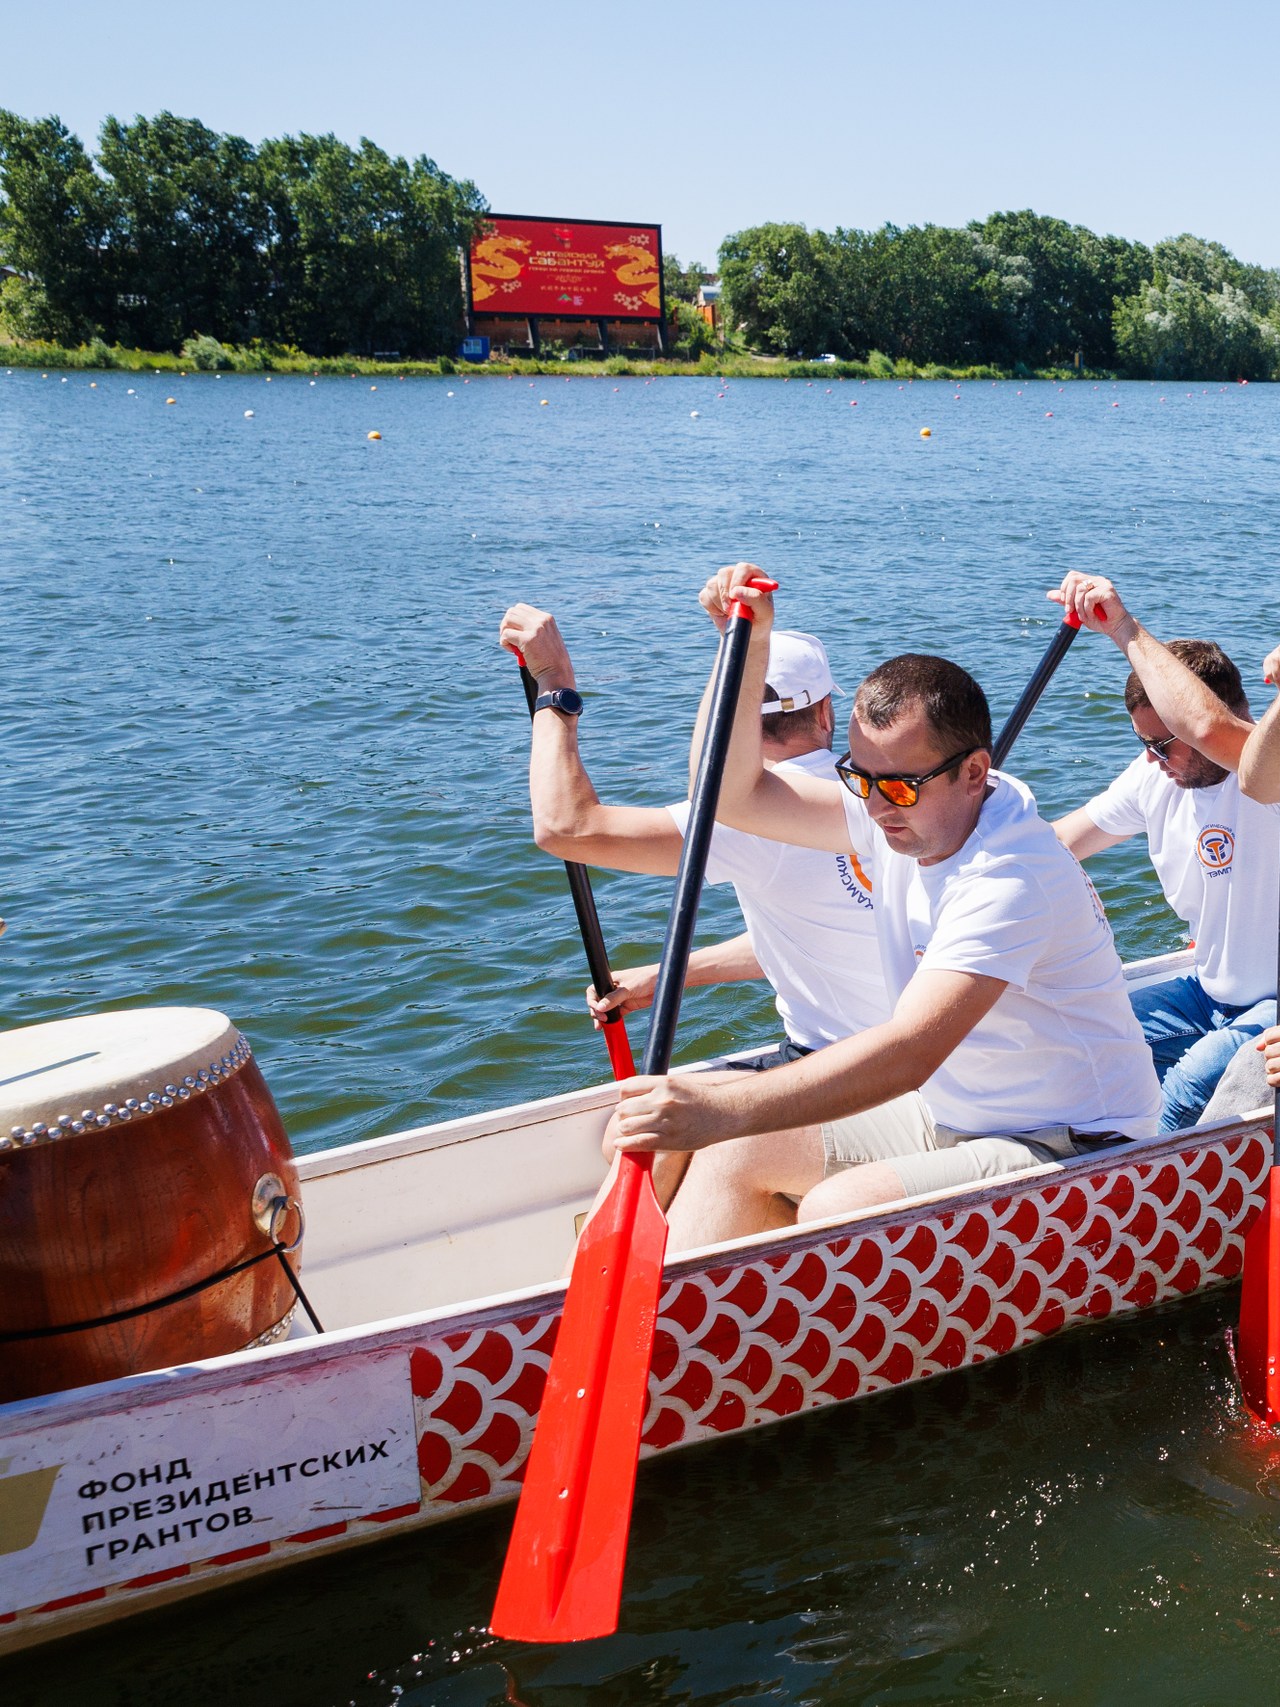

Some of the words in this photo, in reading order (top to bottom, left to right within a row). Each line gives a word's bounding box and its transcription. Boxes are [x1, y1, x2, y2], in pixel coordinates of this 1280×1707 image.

[835, 855, 874, 910] КАМСКИ
[77, 1457, 192, 1500] ФОНД
[81, 1439, 390, 1535] ПРЕЗИДЕНТСКИХ
[85, 1506, 254, 1567] ГРАНТОВ
